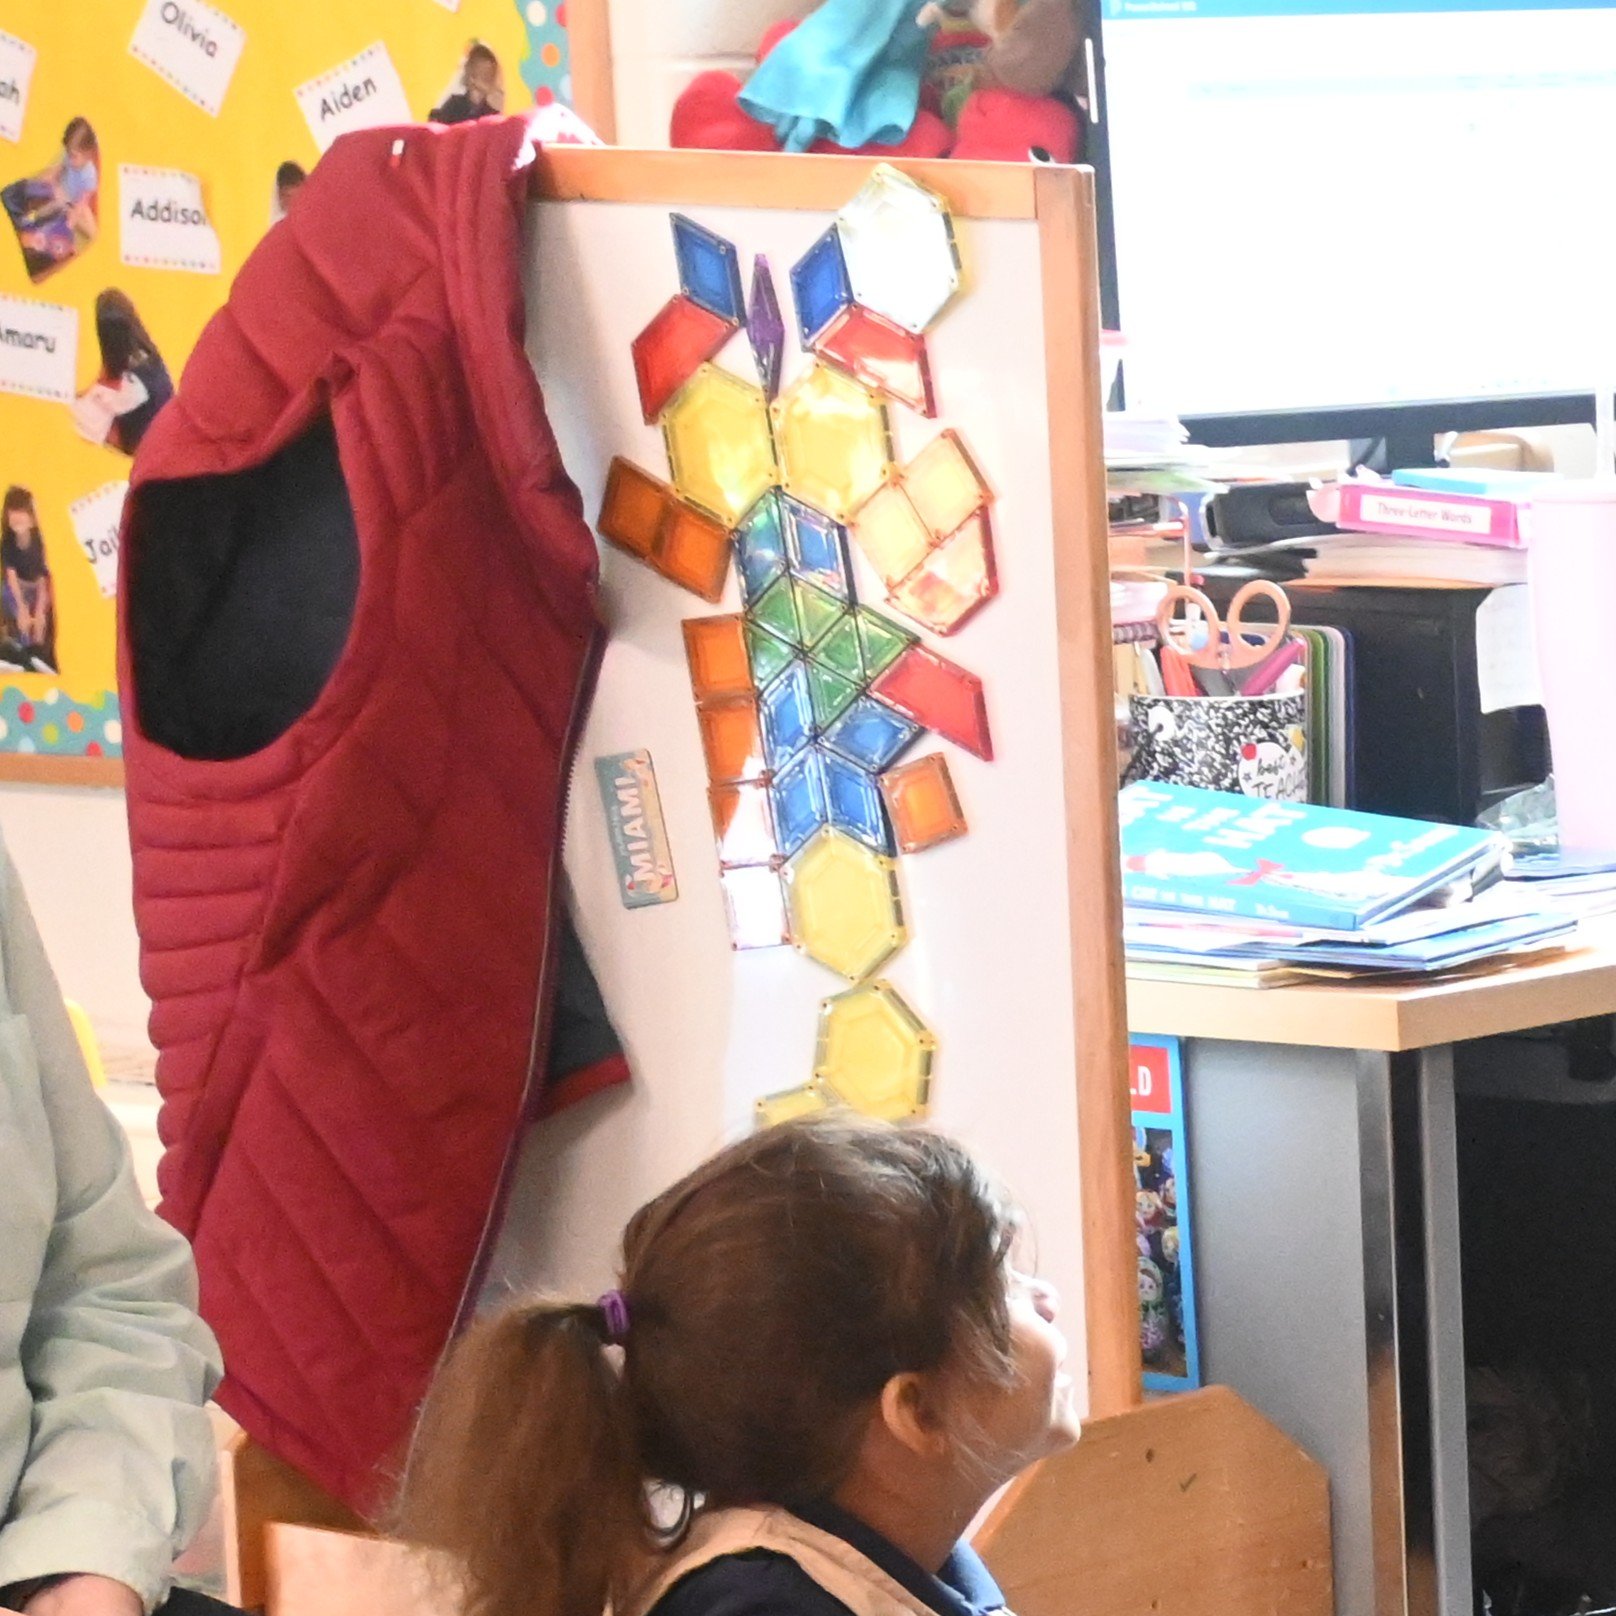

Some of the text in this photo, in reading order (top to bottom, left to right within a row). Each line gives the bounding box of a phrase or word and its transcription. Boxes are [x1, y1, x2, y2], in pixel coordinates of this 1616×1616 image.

[160, 1, 219, 59] Olivia
[319, 76, 377, 121] Aiden
[614, 776, 661, 883] MIAMI
